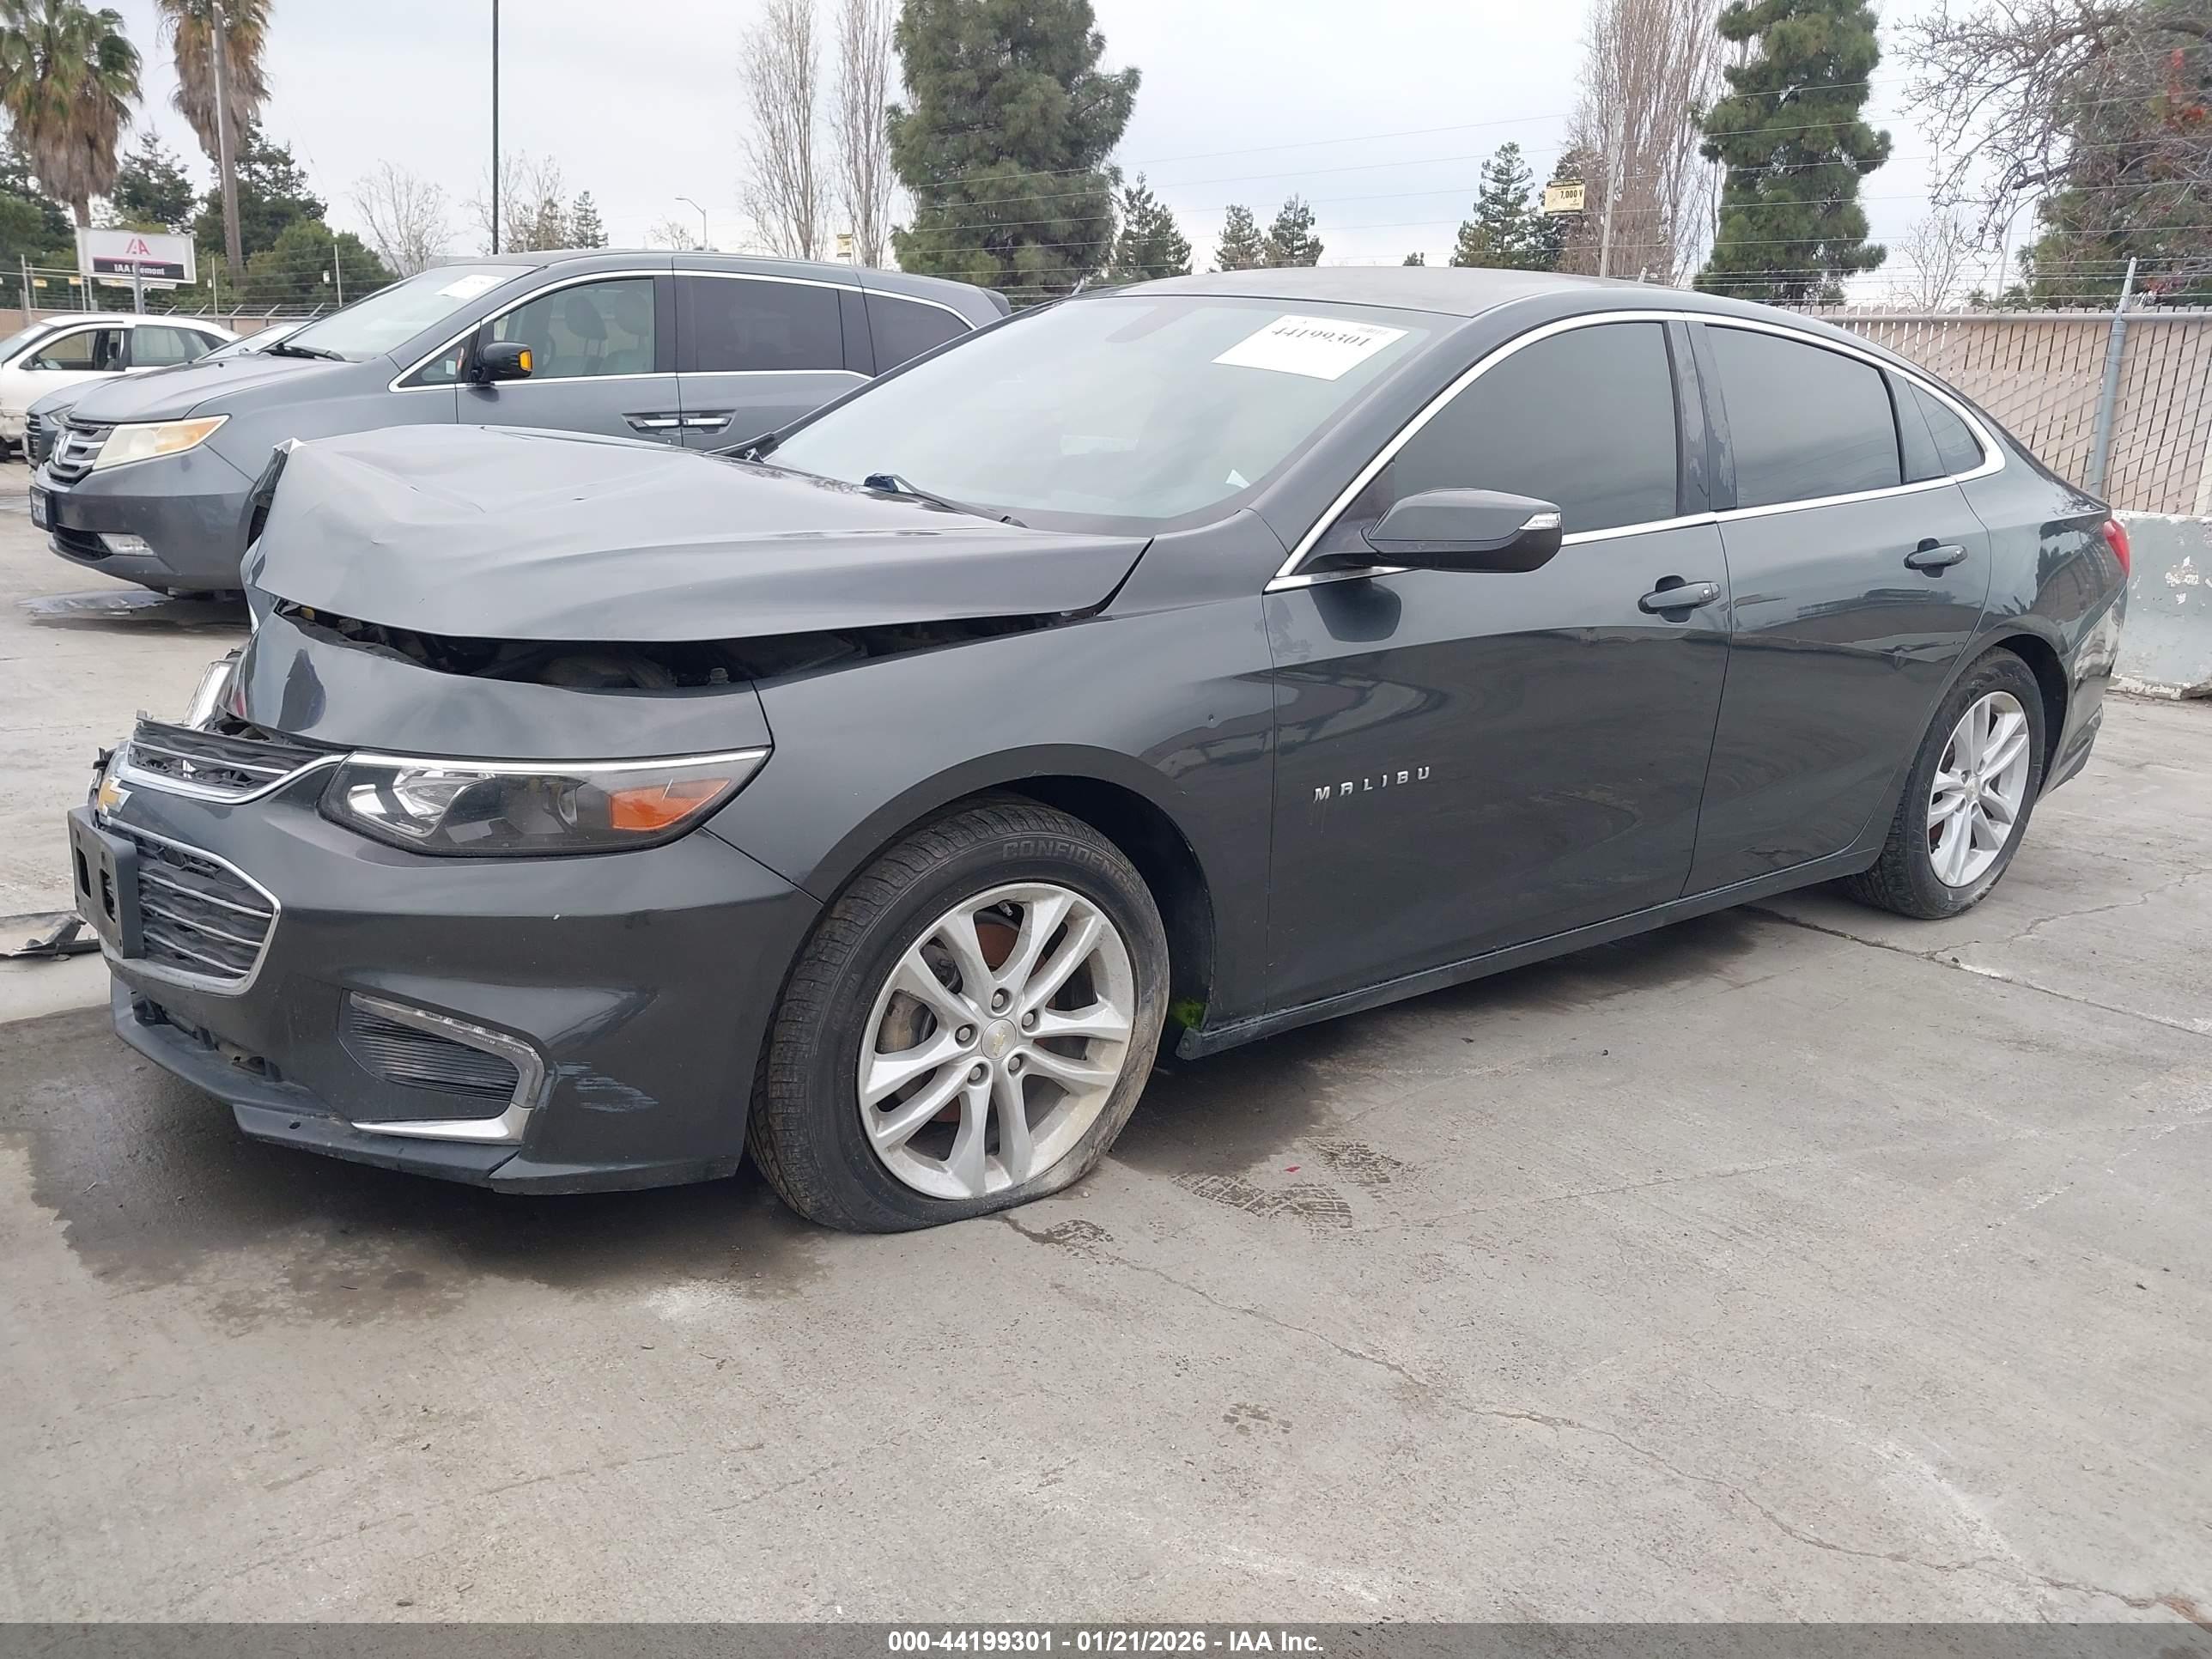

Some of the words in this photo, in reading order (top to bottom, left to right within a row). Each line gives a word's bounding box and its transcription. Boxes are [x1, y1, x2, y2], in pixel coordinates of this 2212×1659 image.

[114, 264, 131, 273] IAA
[1272, 327, 1371, 347] 44199301
[1313, 766, 1430, 804] MALIBU
